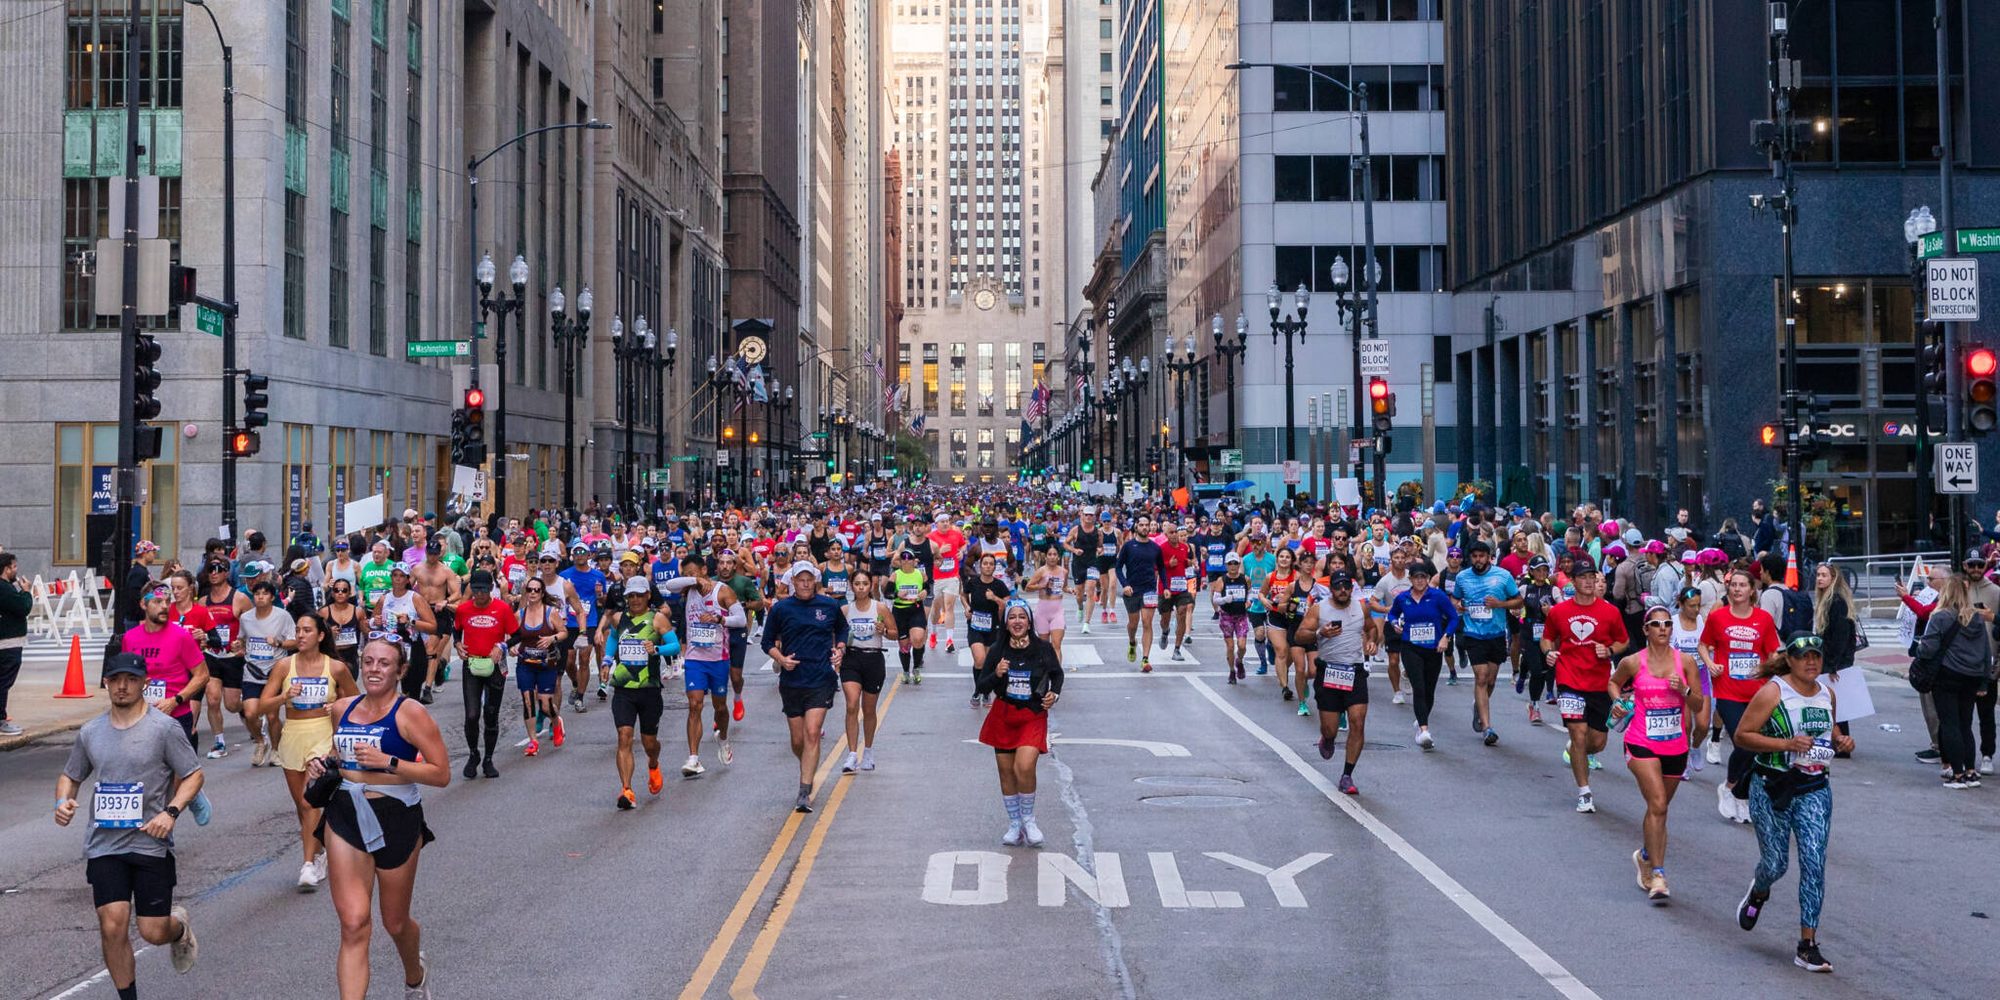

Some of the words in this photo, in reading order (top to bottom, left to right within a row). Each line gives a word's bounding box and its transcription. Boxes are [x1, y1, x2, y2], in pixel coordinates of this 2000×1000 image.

[1931, 267, 1947, 281] DO
[1951, 267, 1975, 281] NOT
[1931, 287, 1976, 301] BLOCK
[1931, 304, 1976, 315] INTERSECTION
[416, 344, 448, 354] Washington
[1362, 344, 1372, 353] DO
[1374, 344, 1388, 352] NOT
[1362, 355, 1389, 364] BLOCK
[1945, 448, 1973, 459] ONE
[1945, 461, 1973, 473] WAY
[93, 491, 111, 499] AVA
[301, 686, 326, 697] 4178
[1648, 716, 1680, 730] J32145
[1800, 721, 1831, 730] HEROES
[96, 796, 139, 812] J39376
[921, 851, 1334, 908] ONLY
